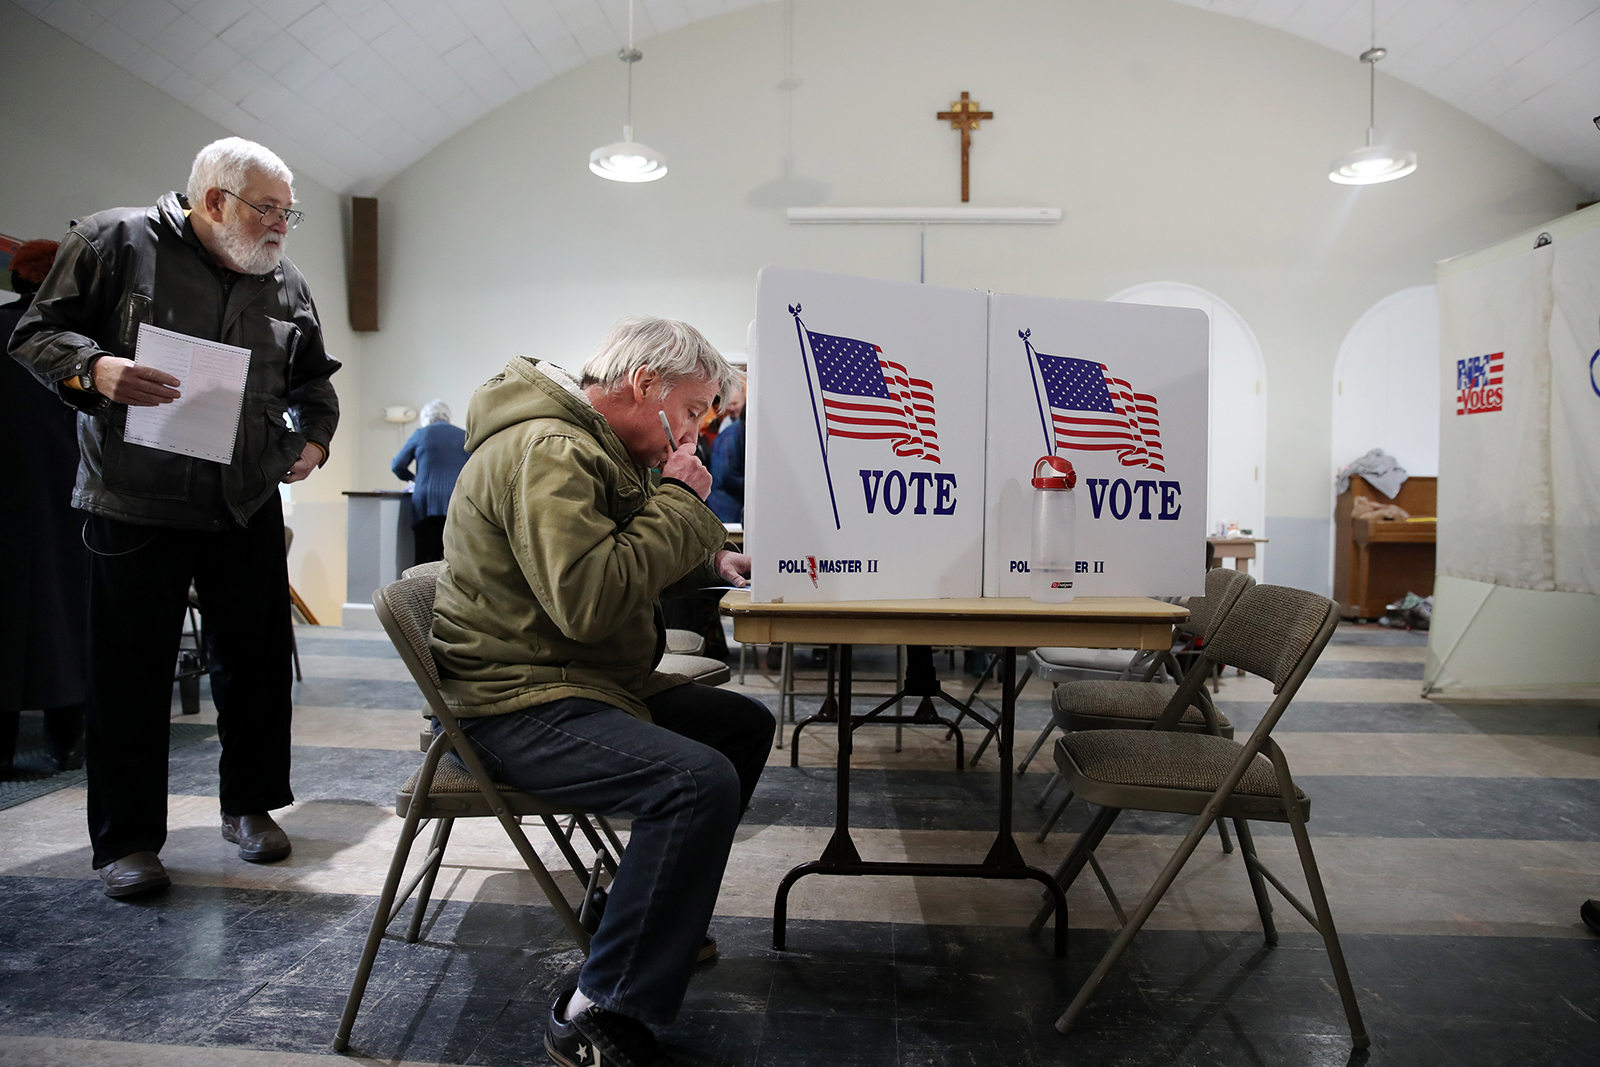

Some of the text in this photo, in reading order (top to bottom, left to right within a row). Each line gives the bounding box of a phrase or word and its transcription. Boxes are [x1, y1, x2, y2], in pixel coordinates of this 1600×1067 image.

[1461, 378, 1503, 410] Votes
[859, 469, 958, 516] VOTE
[1086, 478, 1182, 521] VOTE
[778, 559, 879, 574] POLL MASTER II
[1009, 560, 1031, 574] POL
[1093, 560, 1105, 574] II
